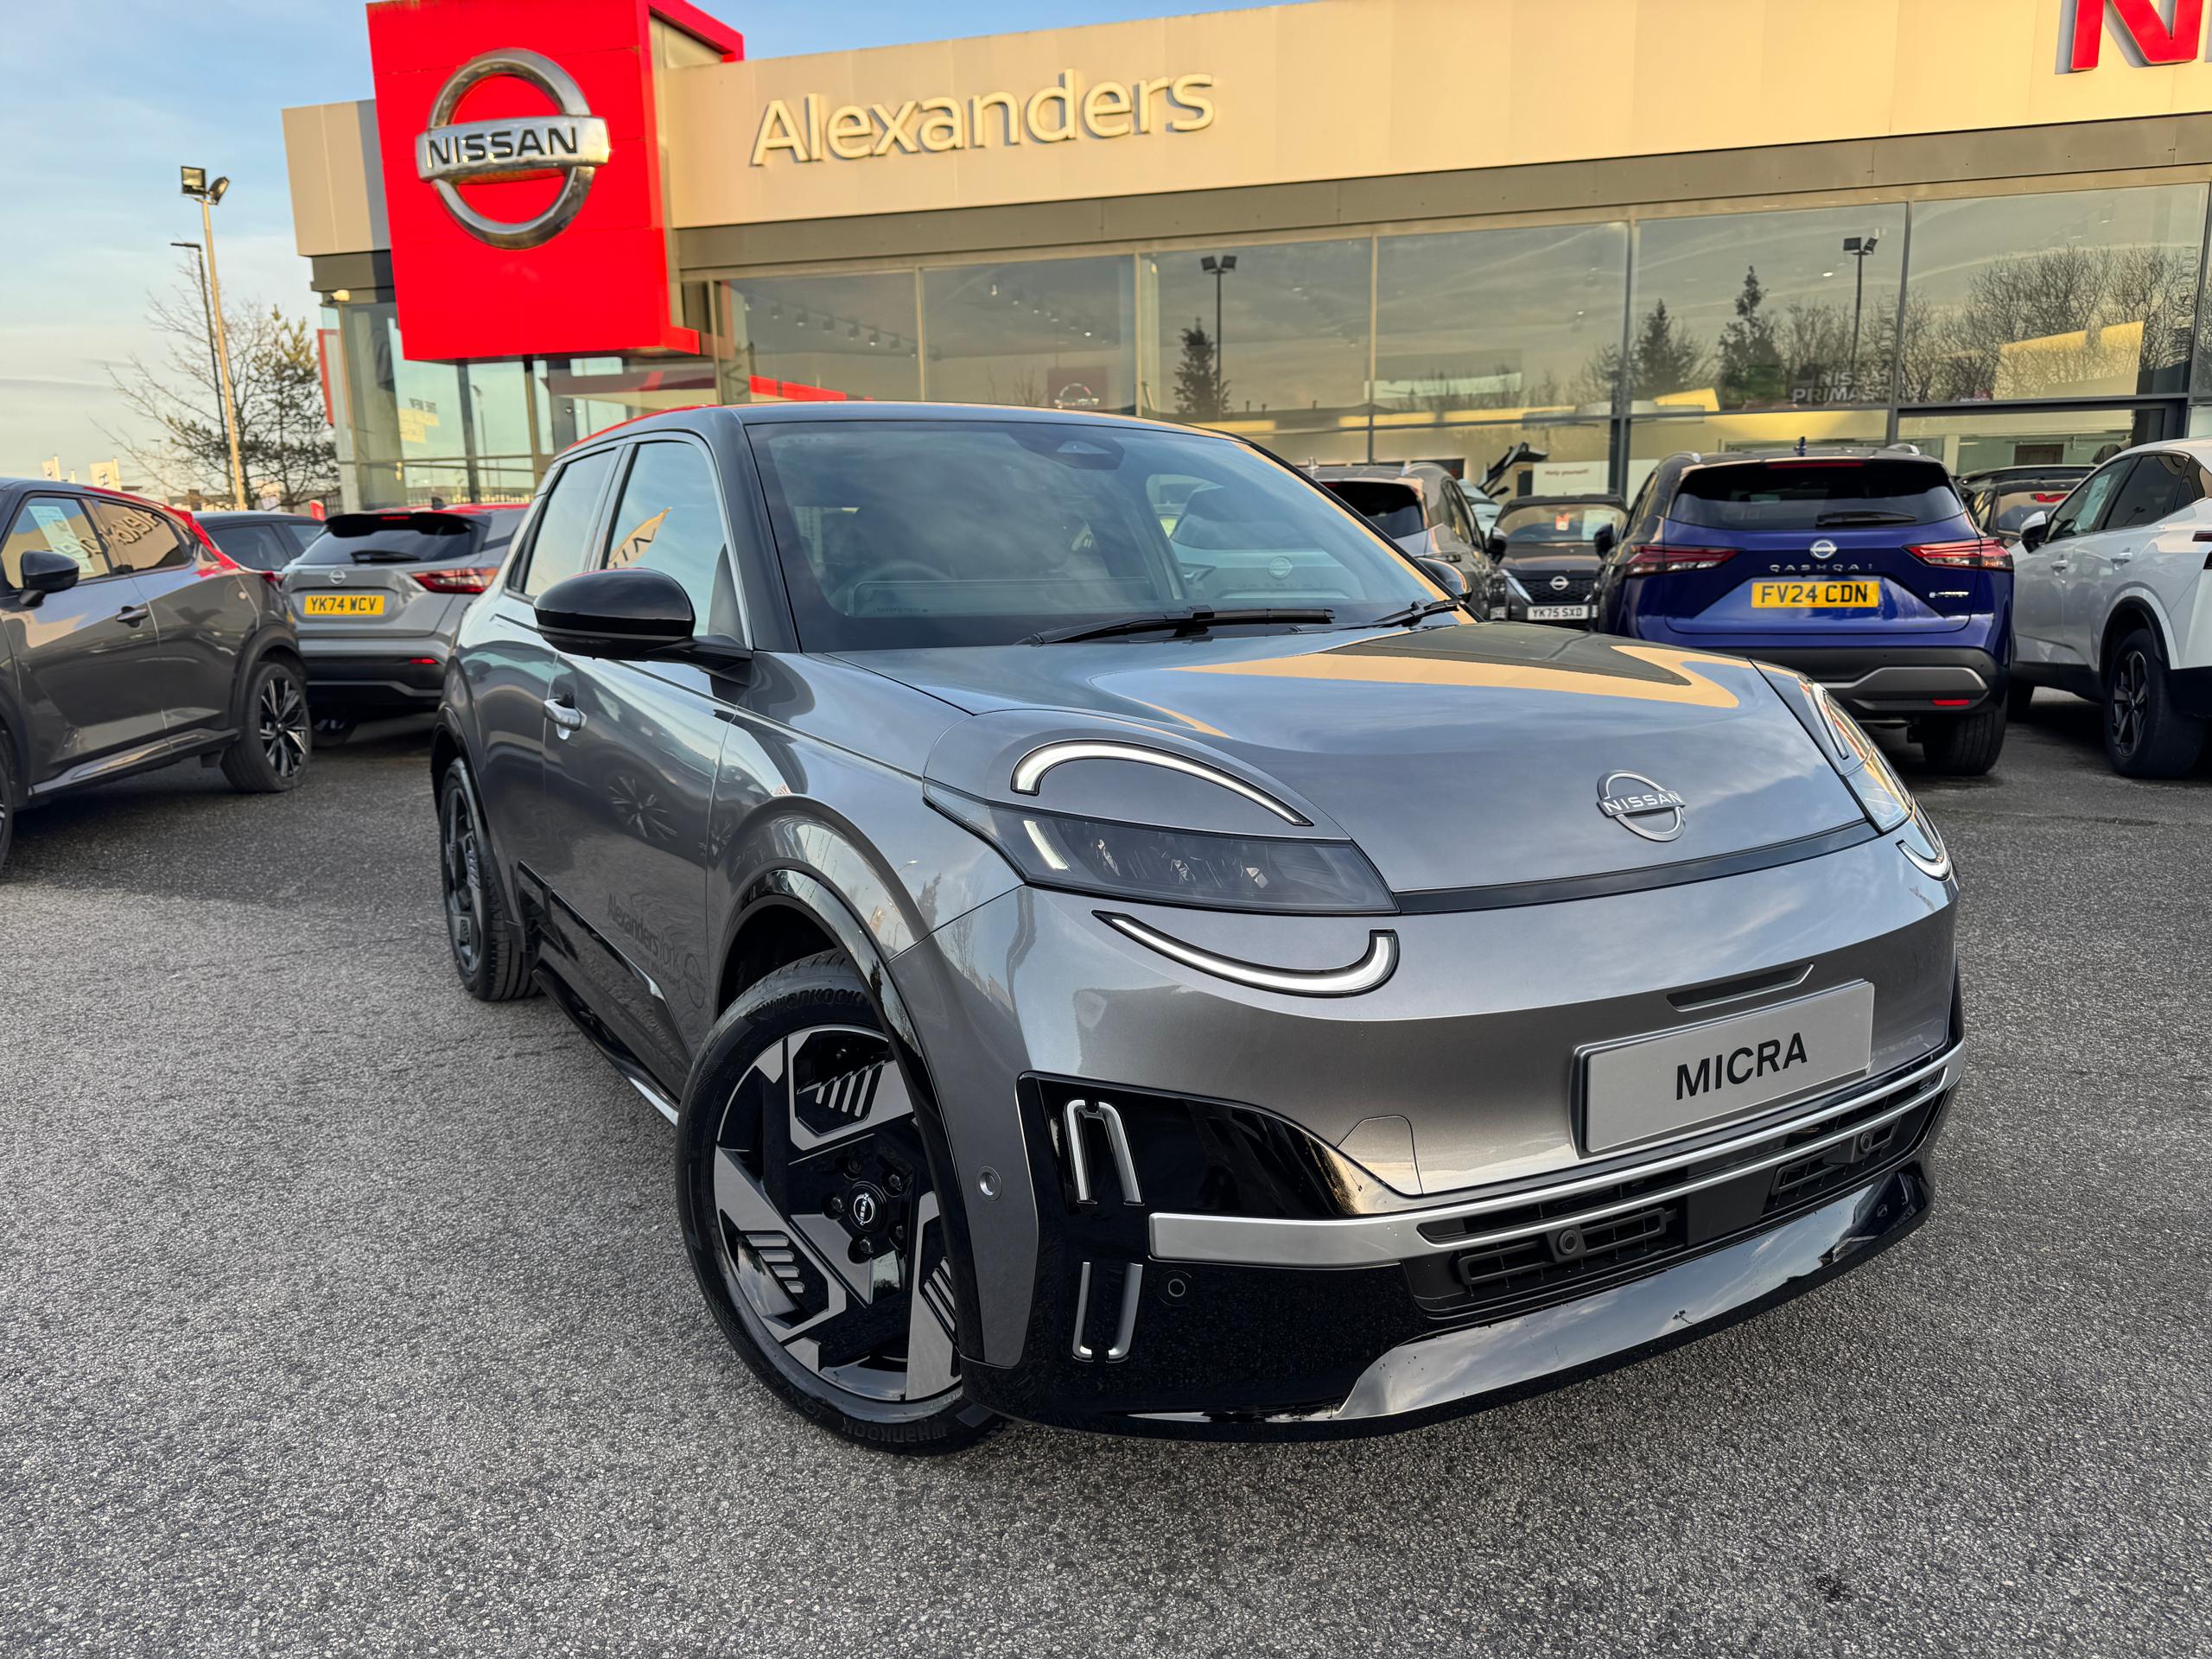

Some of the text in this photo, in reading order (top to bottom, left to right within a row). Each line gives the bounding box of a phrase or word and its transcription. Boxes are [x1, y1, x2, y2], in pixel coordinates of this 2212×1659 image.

[750, 68, 1217, 167] Alexanders
[425, 126, 578, 168] NISSAN
[1769, 563, 1873, 573] QASHQAI
[1761, 584, 1868, 603] FV24 CDN
[311, 597, 377, 612] YK74 WCV
[1533, 607, 1560, 617] YK75
[1603, 792, 1683, 812] NISSAN
[1675, 1032, 1808, 1100] MICRA
